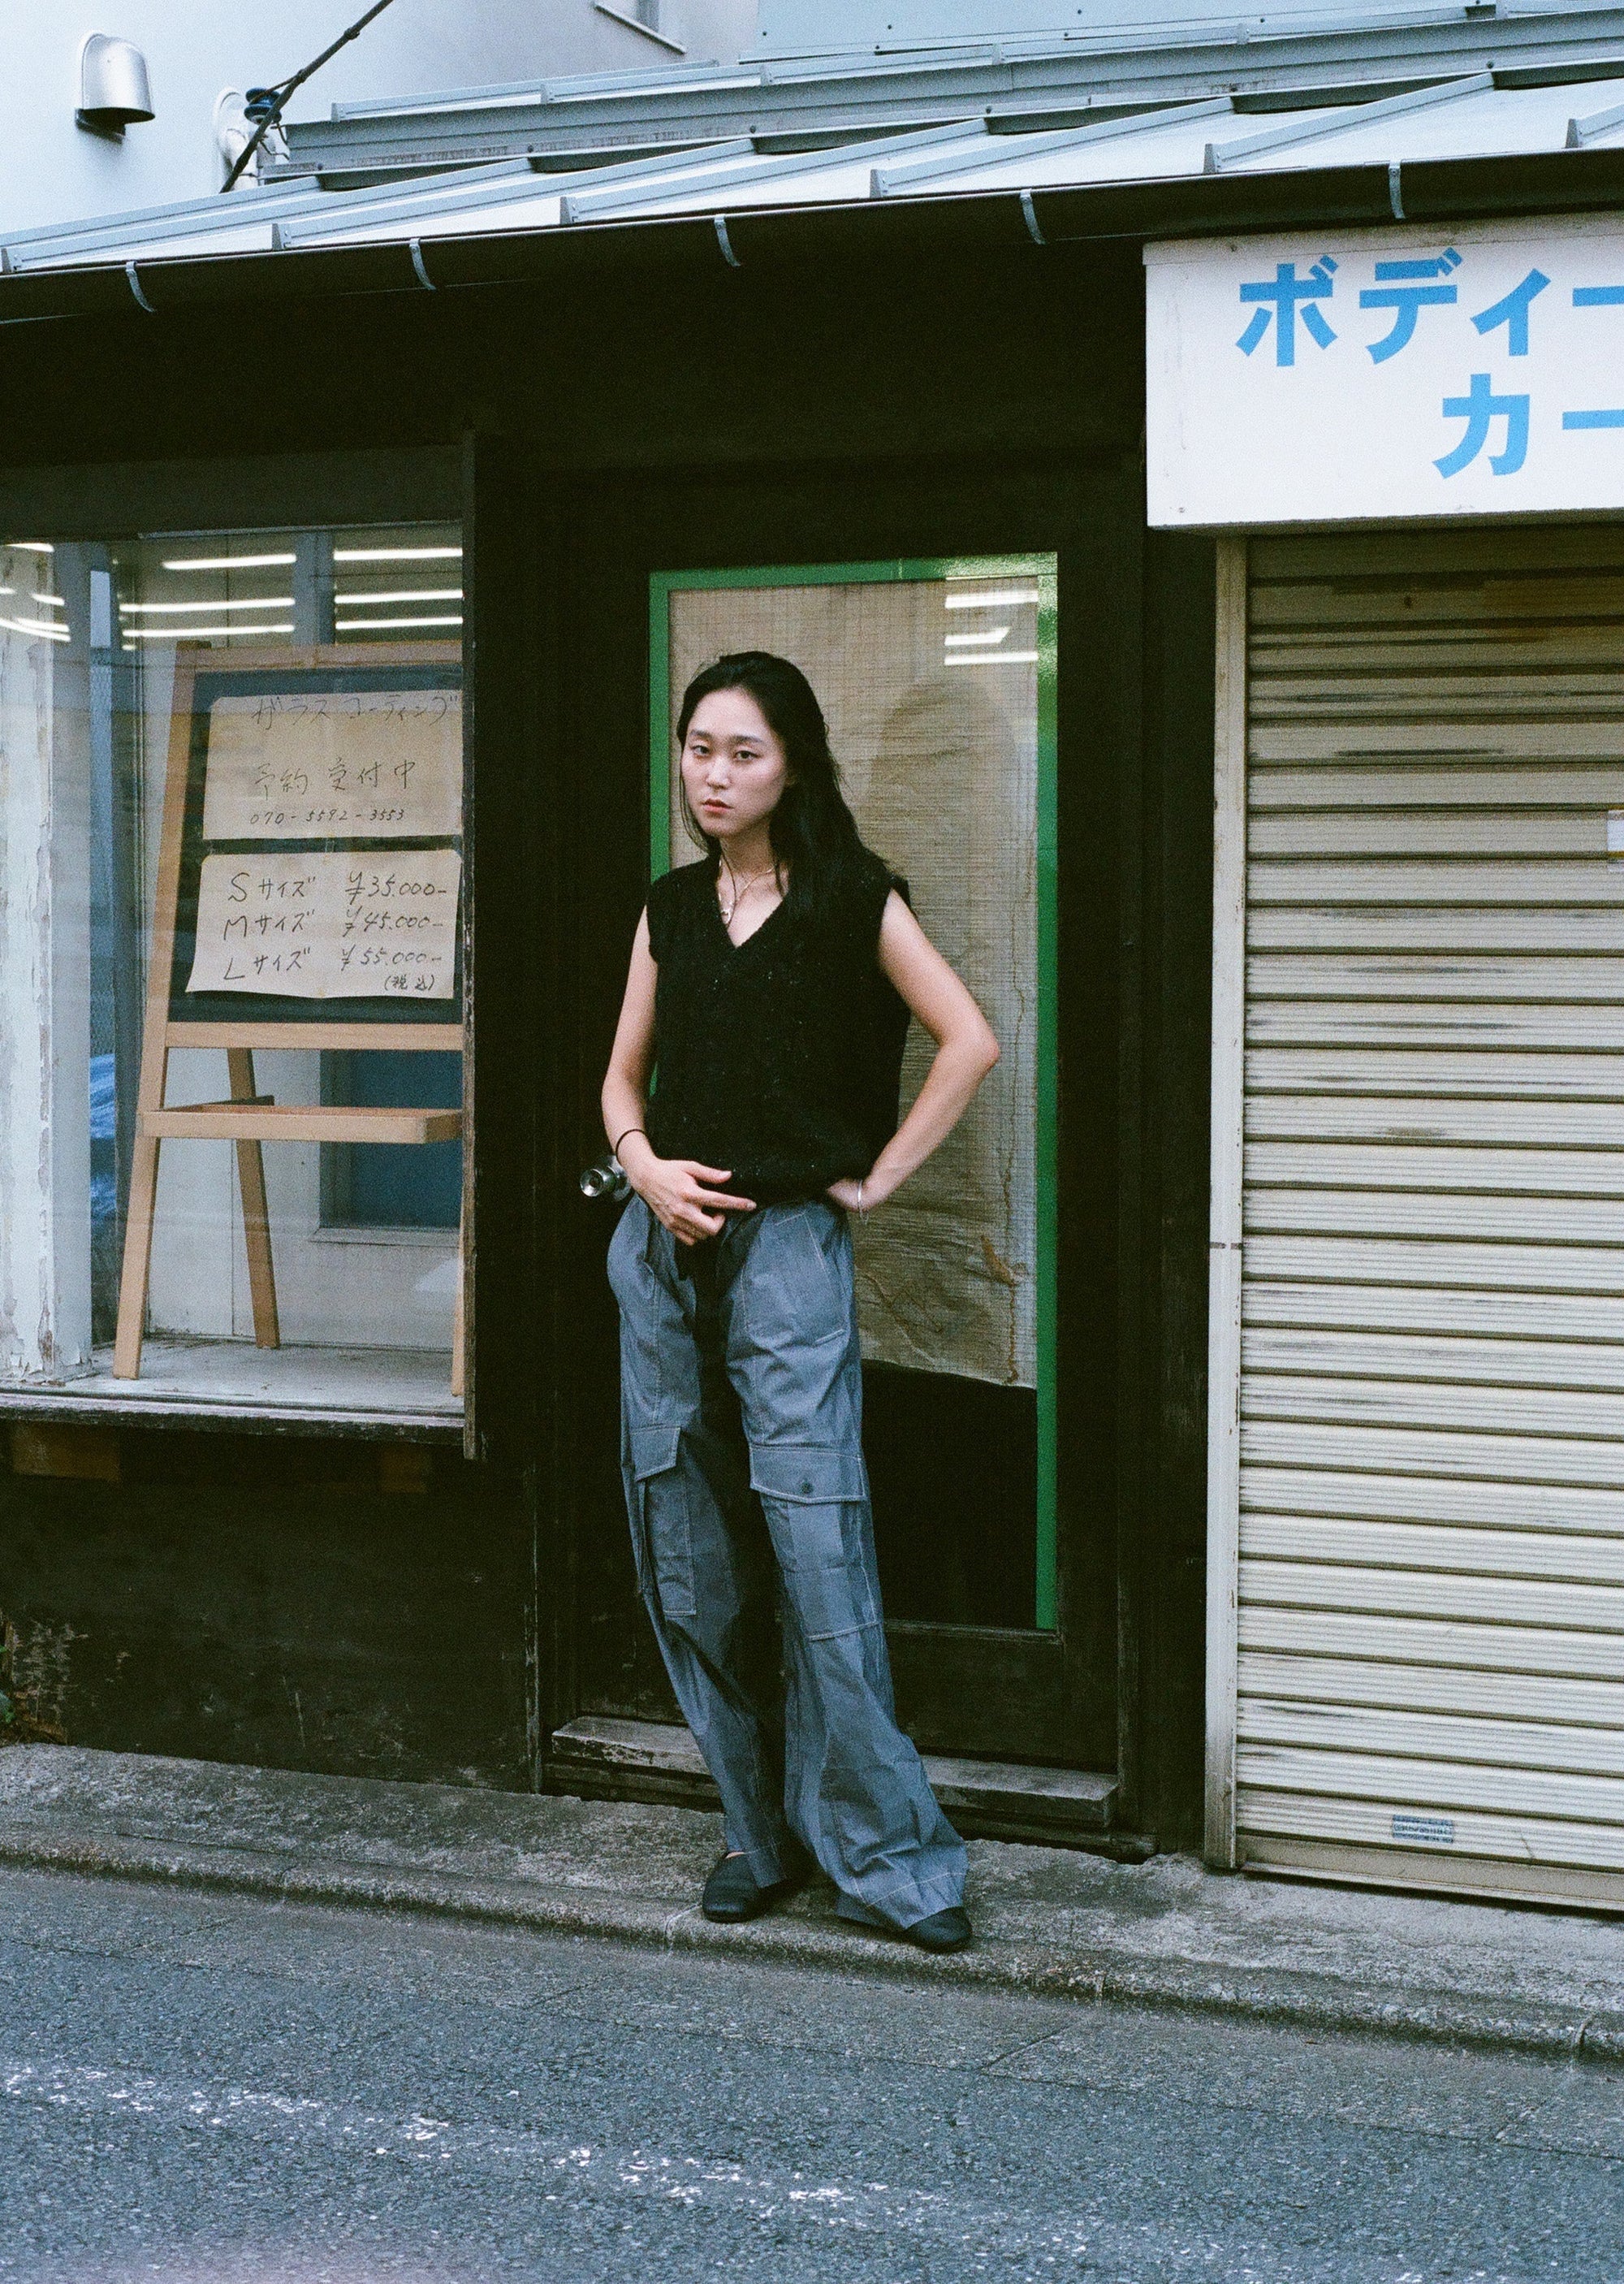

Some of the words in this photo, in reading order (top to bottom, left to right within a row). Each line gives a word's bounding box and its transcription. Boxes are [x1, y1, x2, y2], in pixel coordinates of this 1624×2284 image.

[1235, 247, 1624, 367] ボディー
[1432, 373, 1624, 479] カー
[255, 757, 416, 801] 予約受付中
[227, 872, 316, 902] Sサイズ
[223, 909, 315, 941] Mサイズ
[223, 947, 311, 980] Lサイズ
